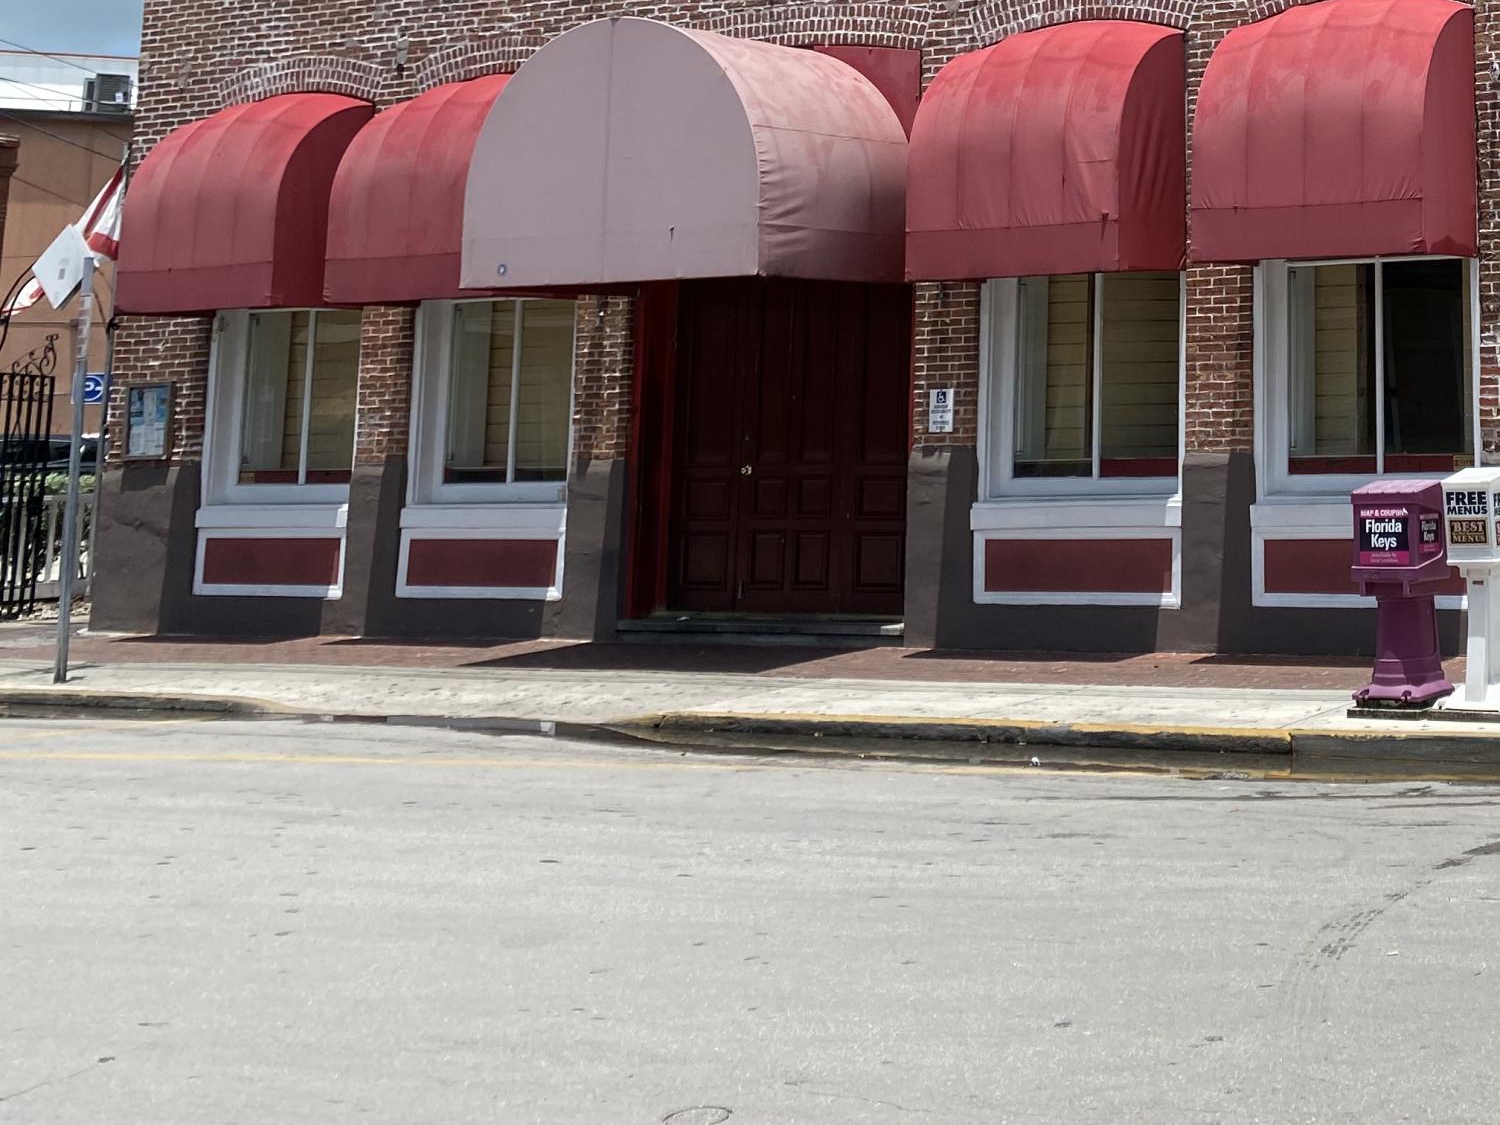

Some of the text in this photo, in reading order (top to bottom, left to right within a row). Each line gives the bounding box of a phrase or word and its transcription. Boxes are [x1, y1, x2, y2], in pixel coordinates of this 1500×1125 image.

[1445, 491, 1487, 506] FREE
[1447, 506, 1488, 515] MENUS
[1365, 519, 1402, 533] Florida
[1452, 521, 1484, 533] BEST
[1371, 534, 1397, 551] Keys
[1424, 531, 1435, 543] Keys
[1453, 534, 1485, 543] MENUS
